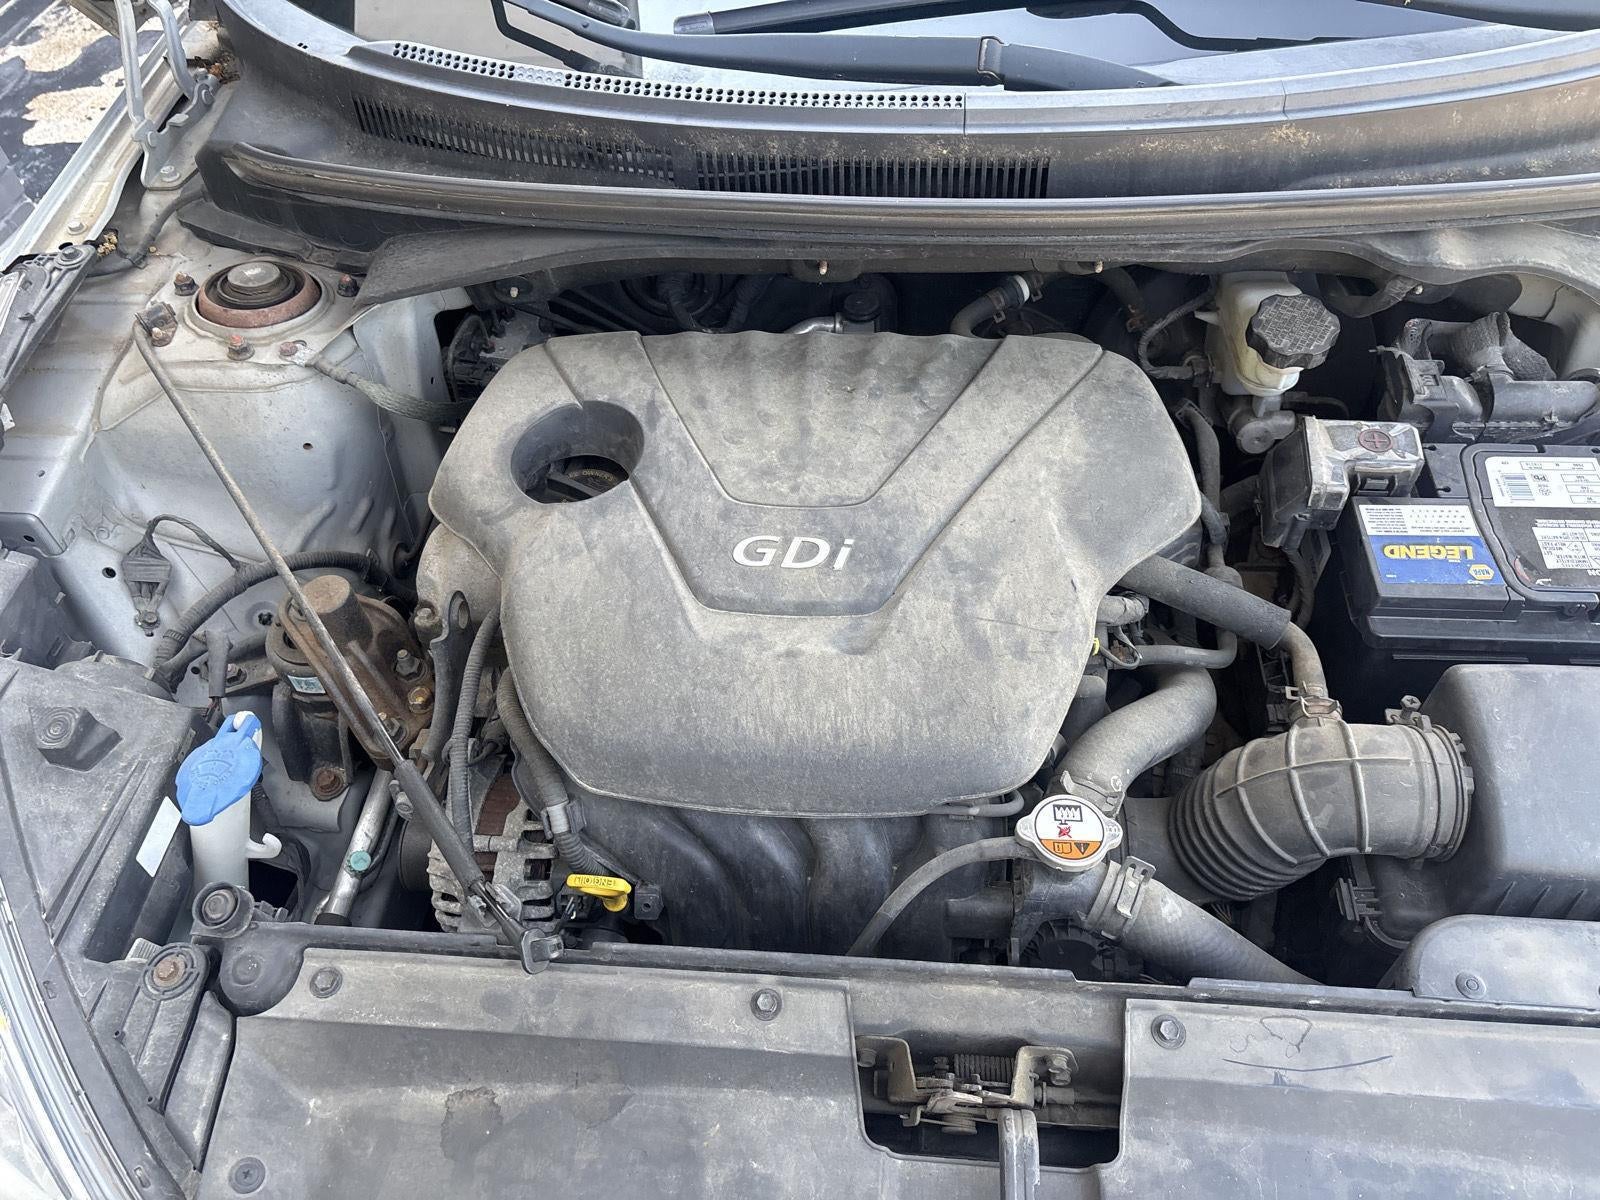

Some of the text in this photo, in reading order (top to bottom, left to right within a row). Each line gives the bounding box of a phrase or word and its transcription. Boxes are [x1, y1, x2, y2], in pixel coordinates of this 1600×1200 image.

[732, 535, 855, 571] GDi
[1384, 545, 1474, 560] LEGEND
[1473, 568, 1490, 576] NAPA
